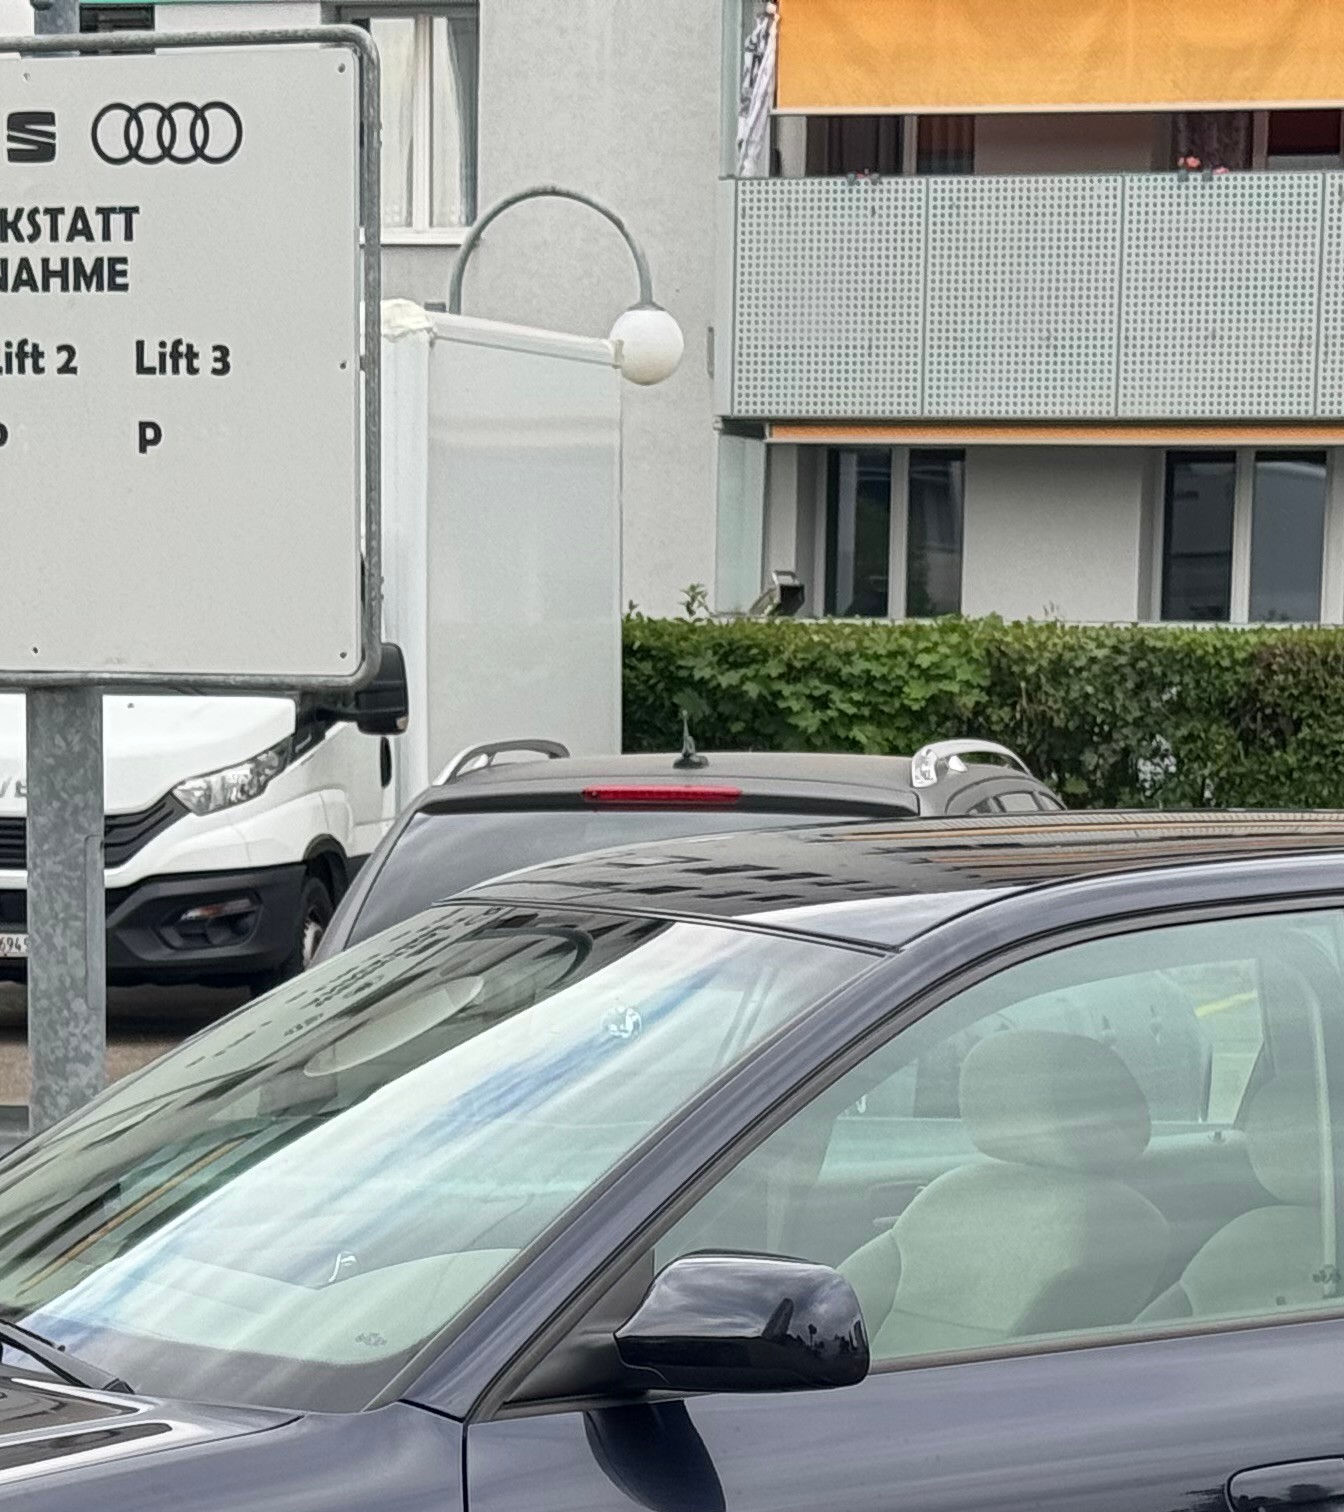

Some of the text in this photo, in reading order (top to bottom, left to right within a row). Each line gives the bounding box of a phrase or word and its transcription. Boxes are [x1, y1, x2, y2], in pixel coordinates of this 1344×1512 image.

[56, 344, 78, 375] 2
[135, 338, 231, 376] Lift 3
[138, 420, 163, 455] P
